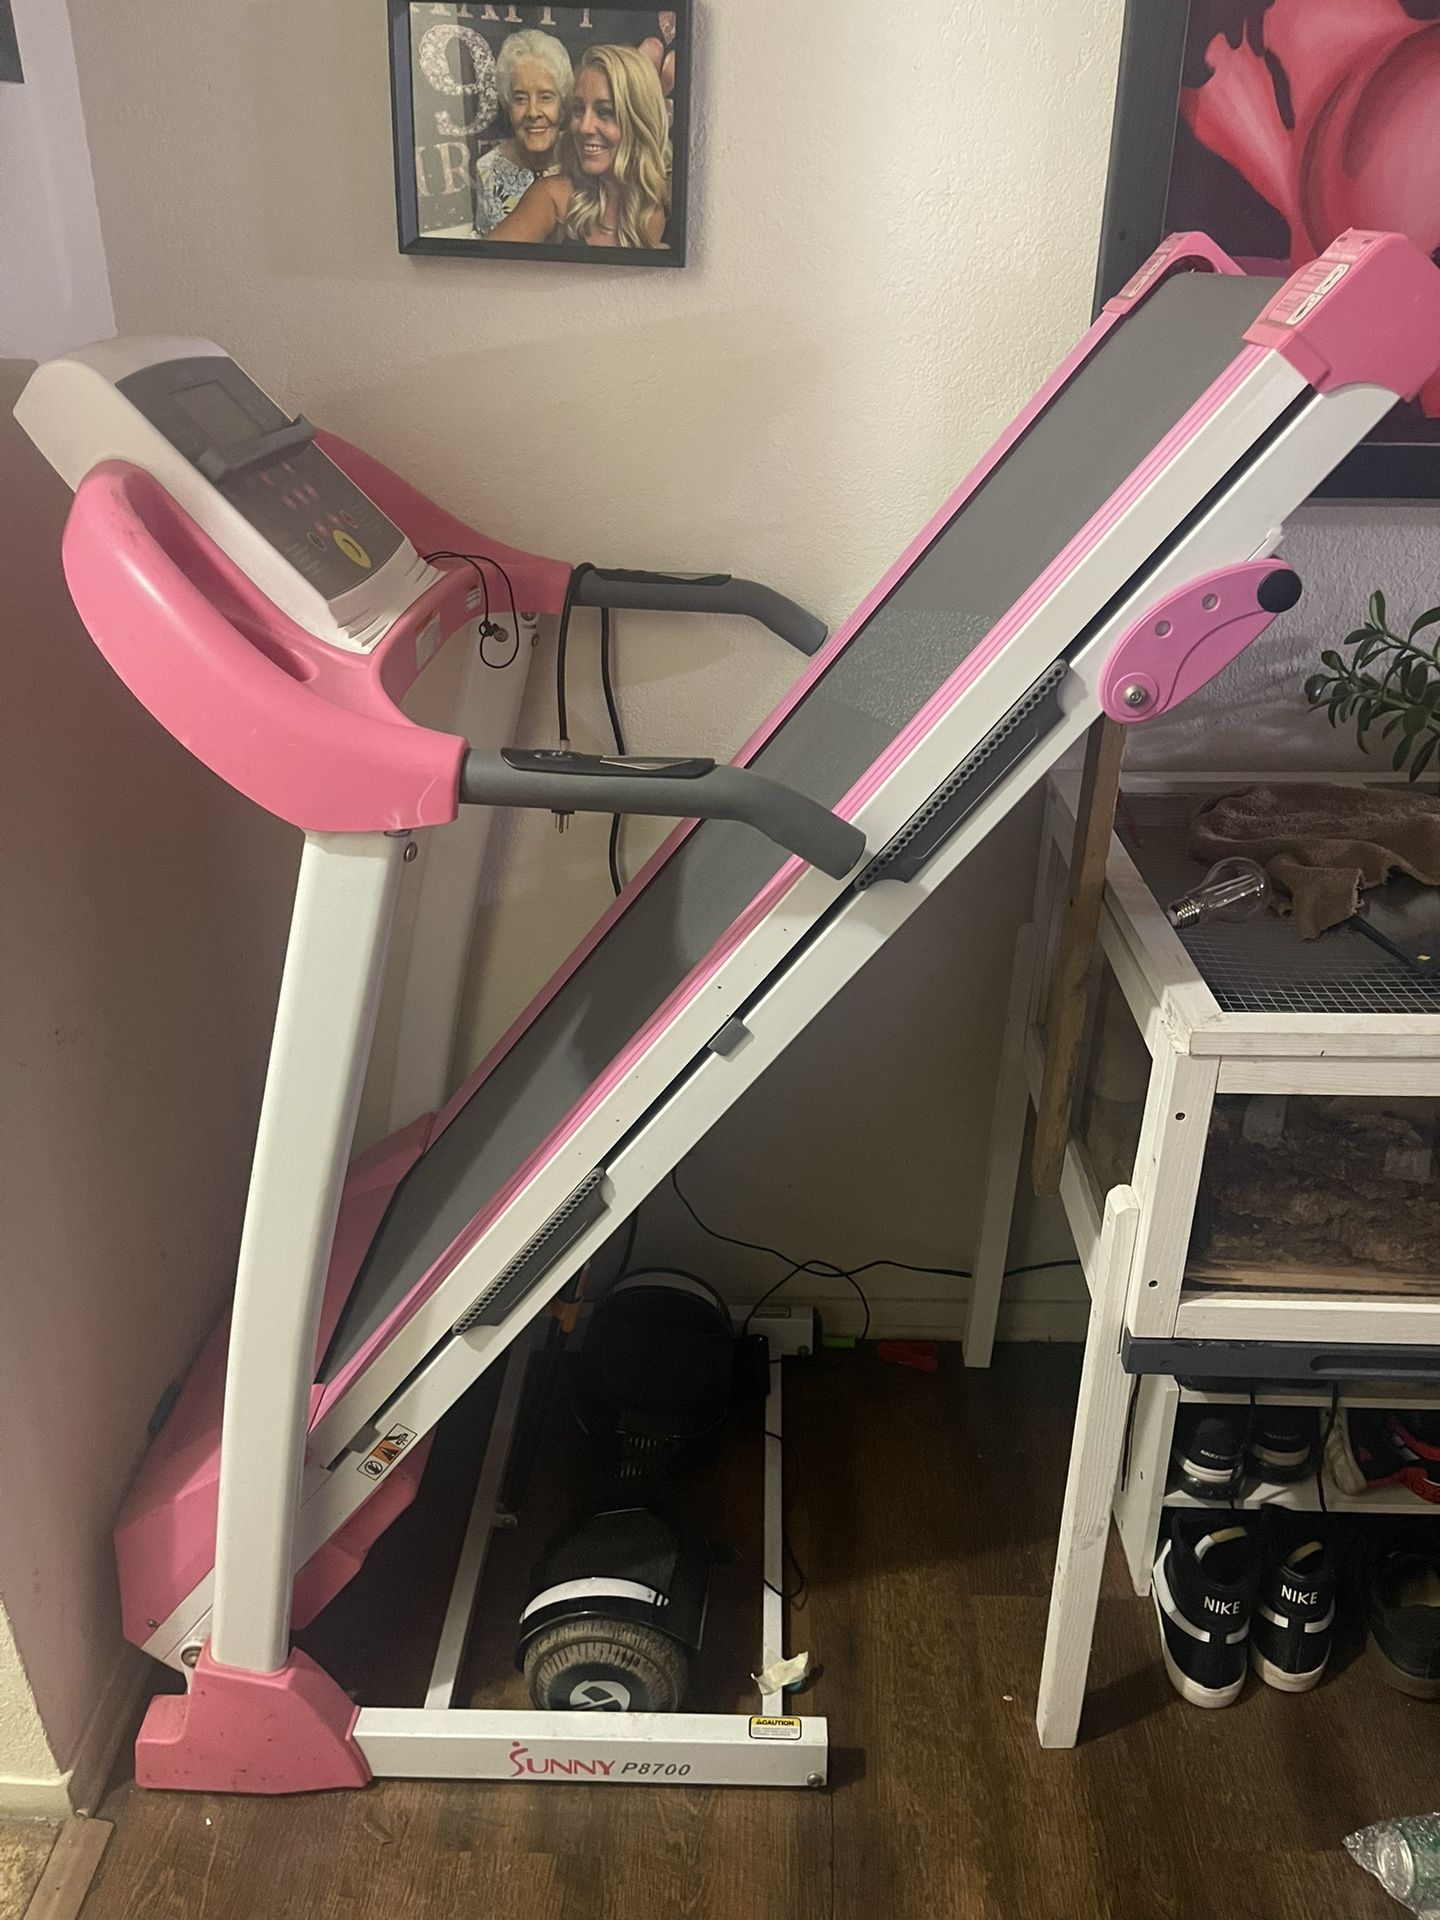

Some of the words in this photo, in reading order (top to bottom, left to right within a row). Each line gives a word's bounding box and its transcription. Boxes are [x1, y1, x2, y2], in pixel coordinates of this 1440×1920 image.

[1203, 1595, 1241, 1615] NIKE
[1281, 1584, 1319, 1606] NIKE
[762, 1719, 795, 1727] CAUTION
[509, 1741, 616, 1778] SUNNY
[621, 1761, 692, 1777] P8700
